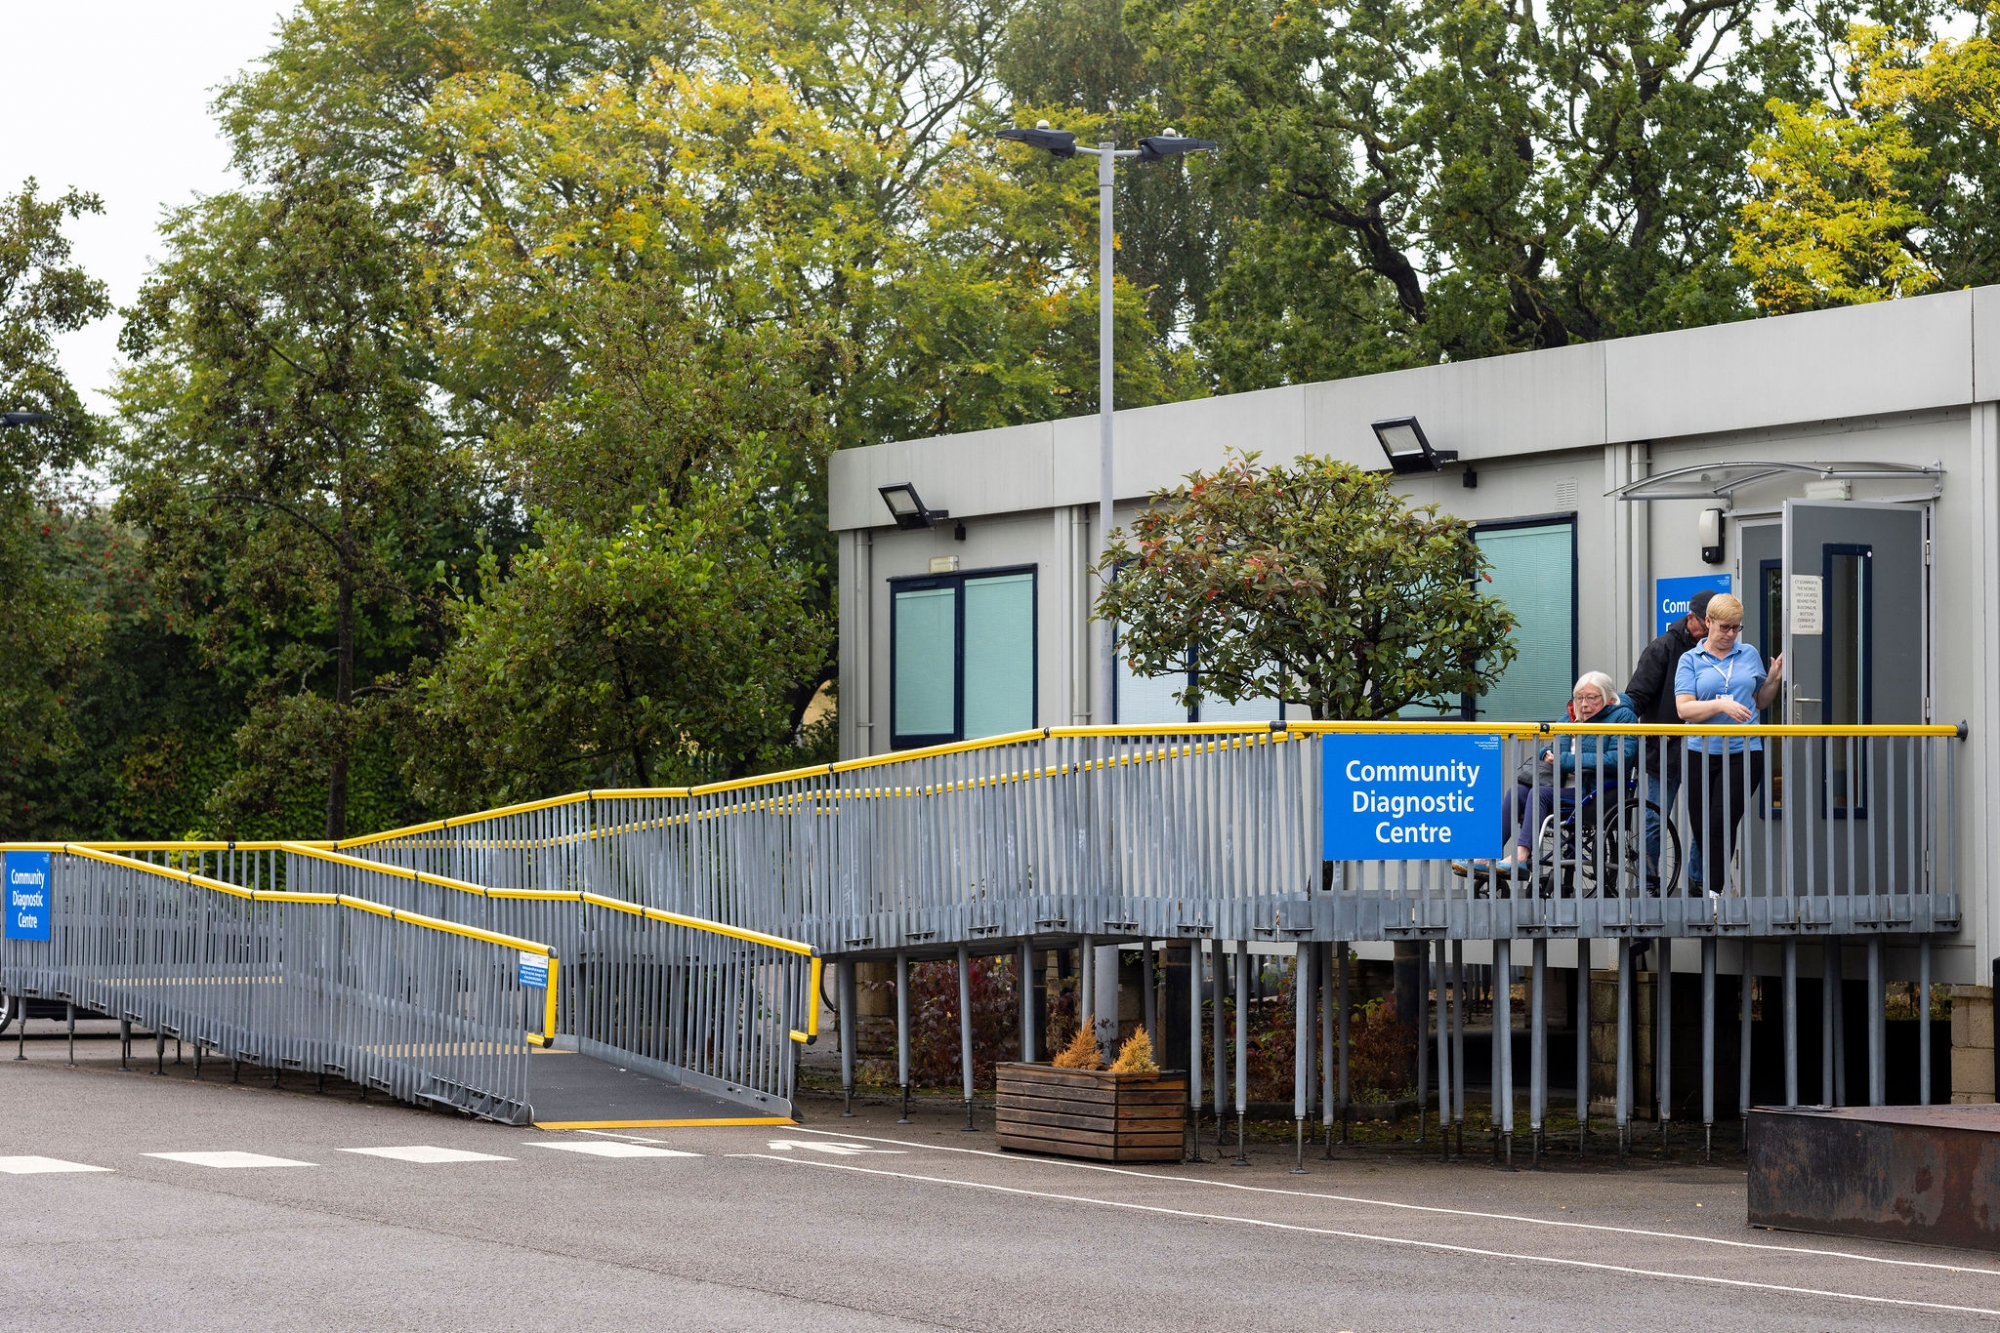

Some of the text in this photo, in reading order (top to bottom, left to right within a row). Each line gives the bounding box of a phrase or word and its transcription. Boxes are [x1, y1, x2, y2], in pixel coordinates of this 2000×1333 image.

[1346, 759, 1480, 788] Community
[1353, 790, 1474, 818] Diagnostic
[1376, 822, 1452, 843] Centre
[11, 868, 45, 889] Community
[12, 890, 43, 910] Diagnostic
[18, 912, 37, 928] Centre
